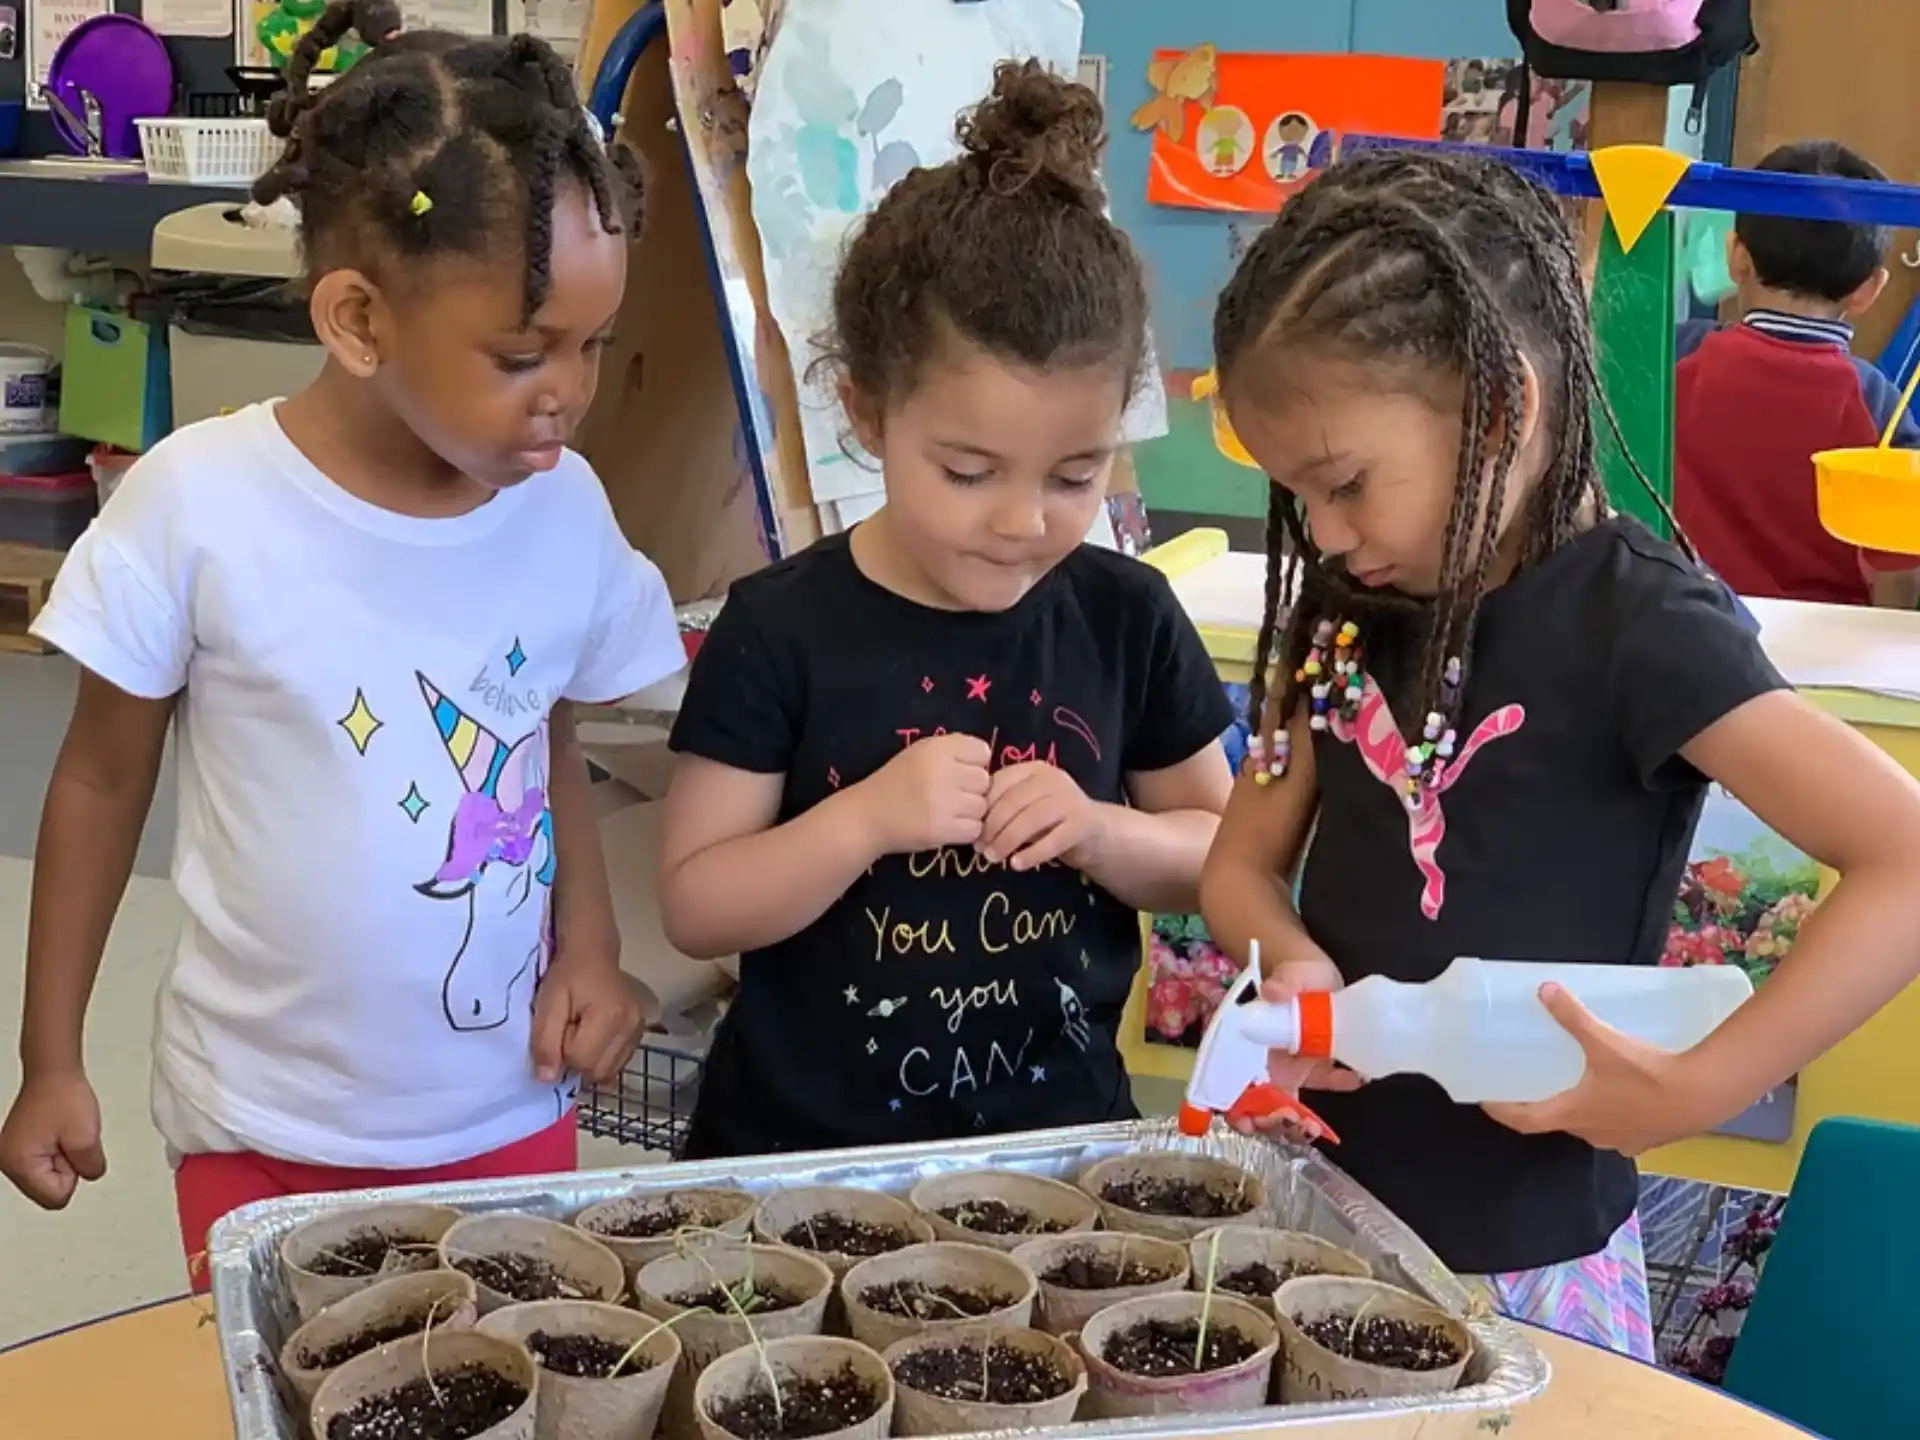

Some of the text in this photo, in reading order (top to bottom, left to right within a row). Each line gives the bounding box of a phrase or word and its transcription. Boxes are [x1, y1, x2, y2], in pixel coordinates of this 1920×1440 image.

[865, 891, 1076, 962] You Can
[929, 979, 1019, 1033] you
[899, 1027, 1034, 1099] CAN
